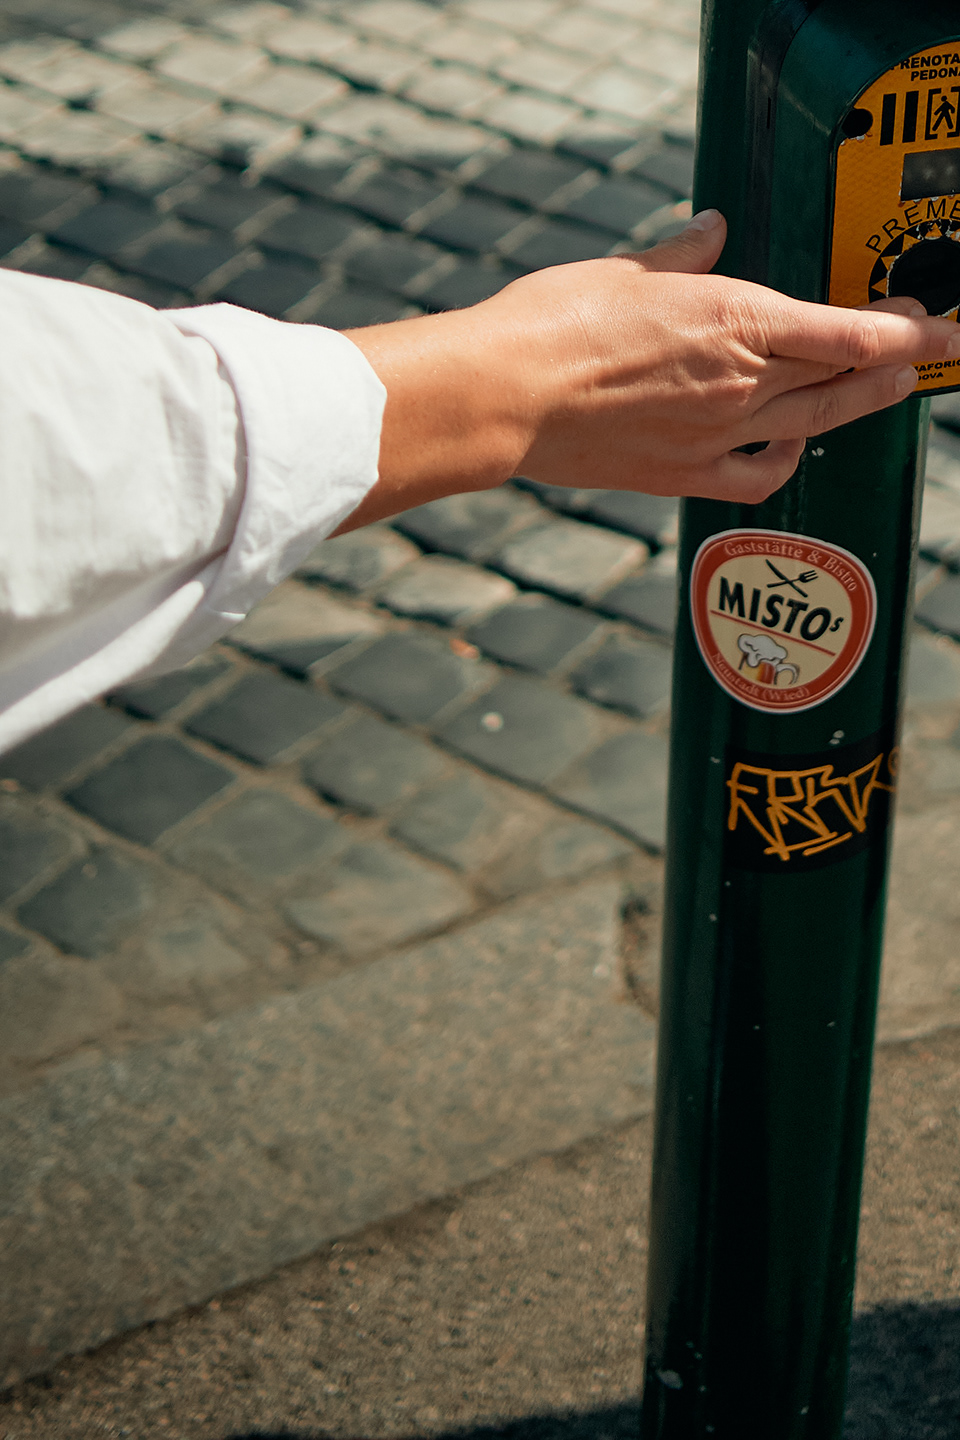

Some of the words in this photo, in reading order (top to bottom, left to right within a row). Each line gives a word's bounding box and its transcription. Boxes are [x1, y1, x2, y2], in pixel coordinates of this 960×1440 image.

[724, 541, 804, 558] Gaststätte
[806, 550, 820, 564] &
[823, 557, 858, 592] Bistro
